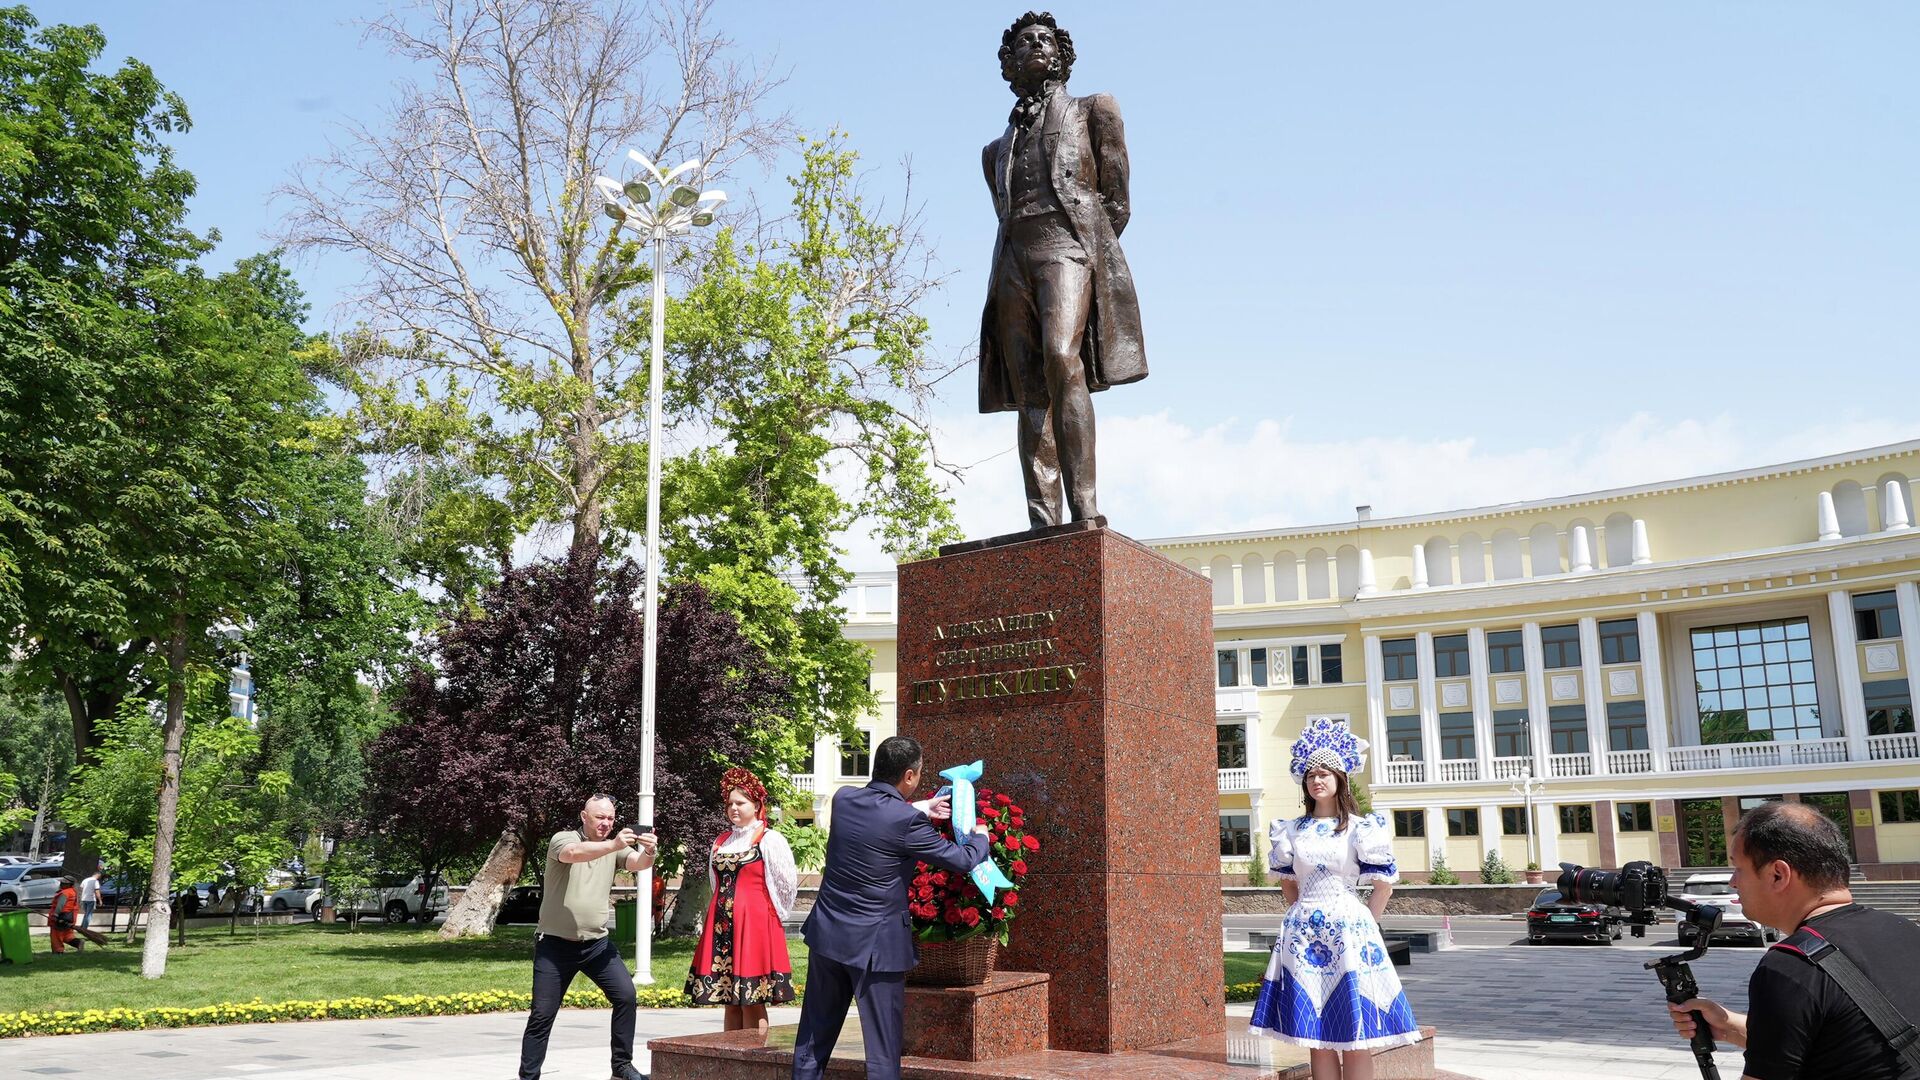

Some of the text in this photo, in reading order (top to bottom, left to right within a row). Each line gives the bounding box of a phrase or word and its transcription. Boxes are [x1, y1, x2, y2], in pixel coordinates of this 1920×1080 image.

[933, 610, 1061, 640] АЛЕКСАНДРУ
[936, 638, 1059, 667] СЕРГЕЕВИЧУ
[913, 662, 1086, 704] ПУШКИНУ
